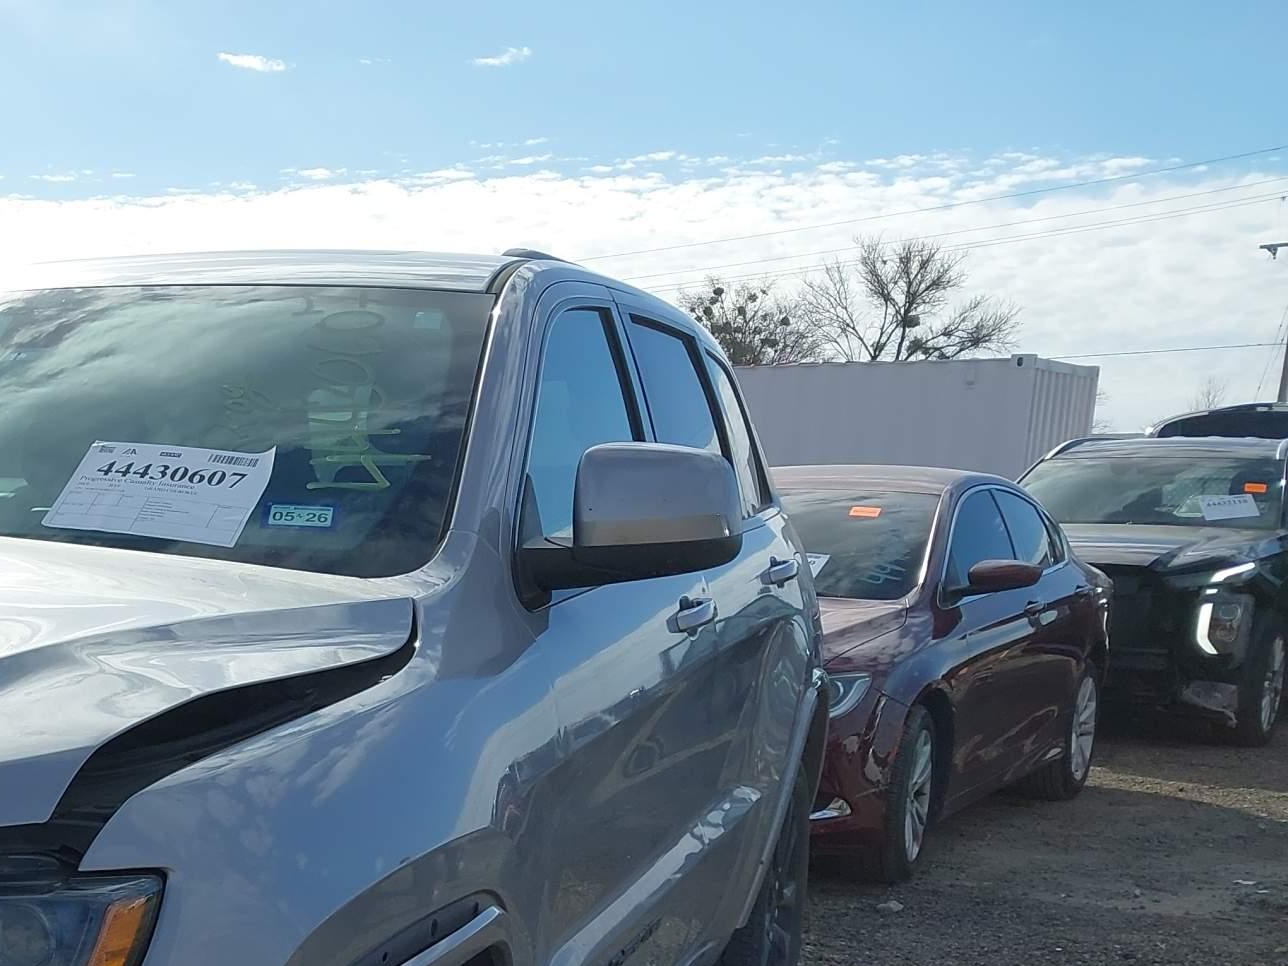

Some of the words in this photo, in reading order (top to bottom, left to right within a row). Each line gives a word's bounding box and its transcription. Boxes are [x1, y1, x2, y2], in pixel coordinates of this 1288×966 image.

[96, 460, 249, 489] 44430607
[272, 511, 296, 522] 05
[305, 512, 329, 523] 26
